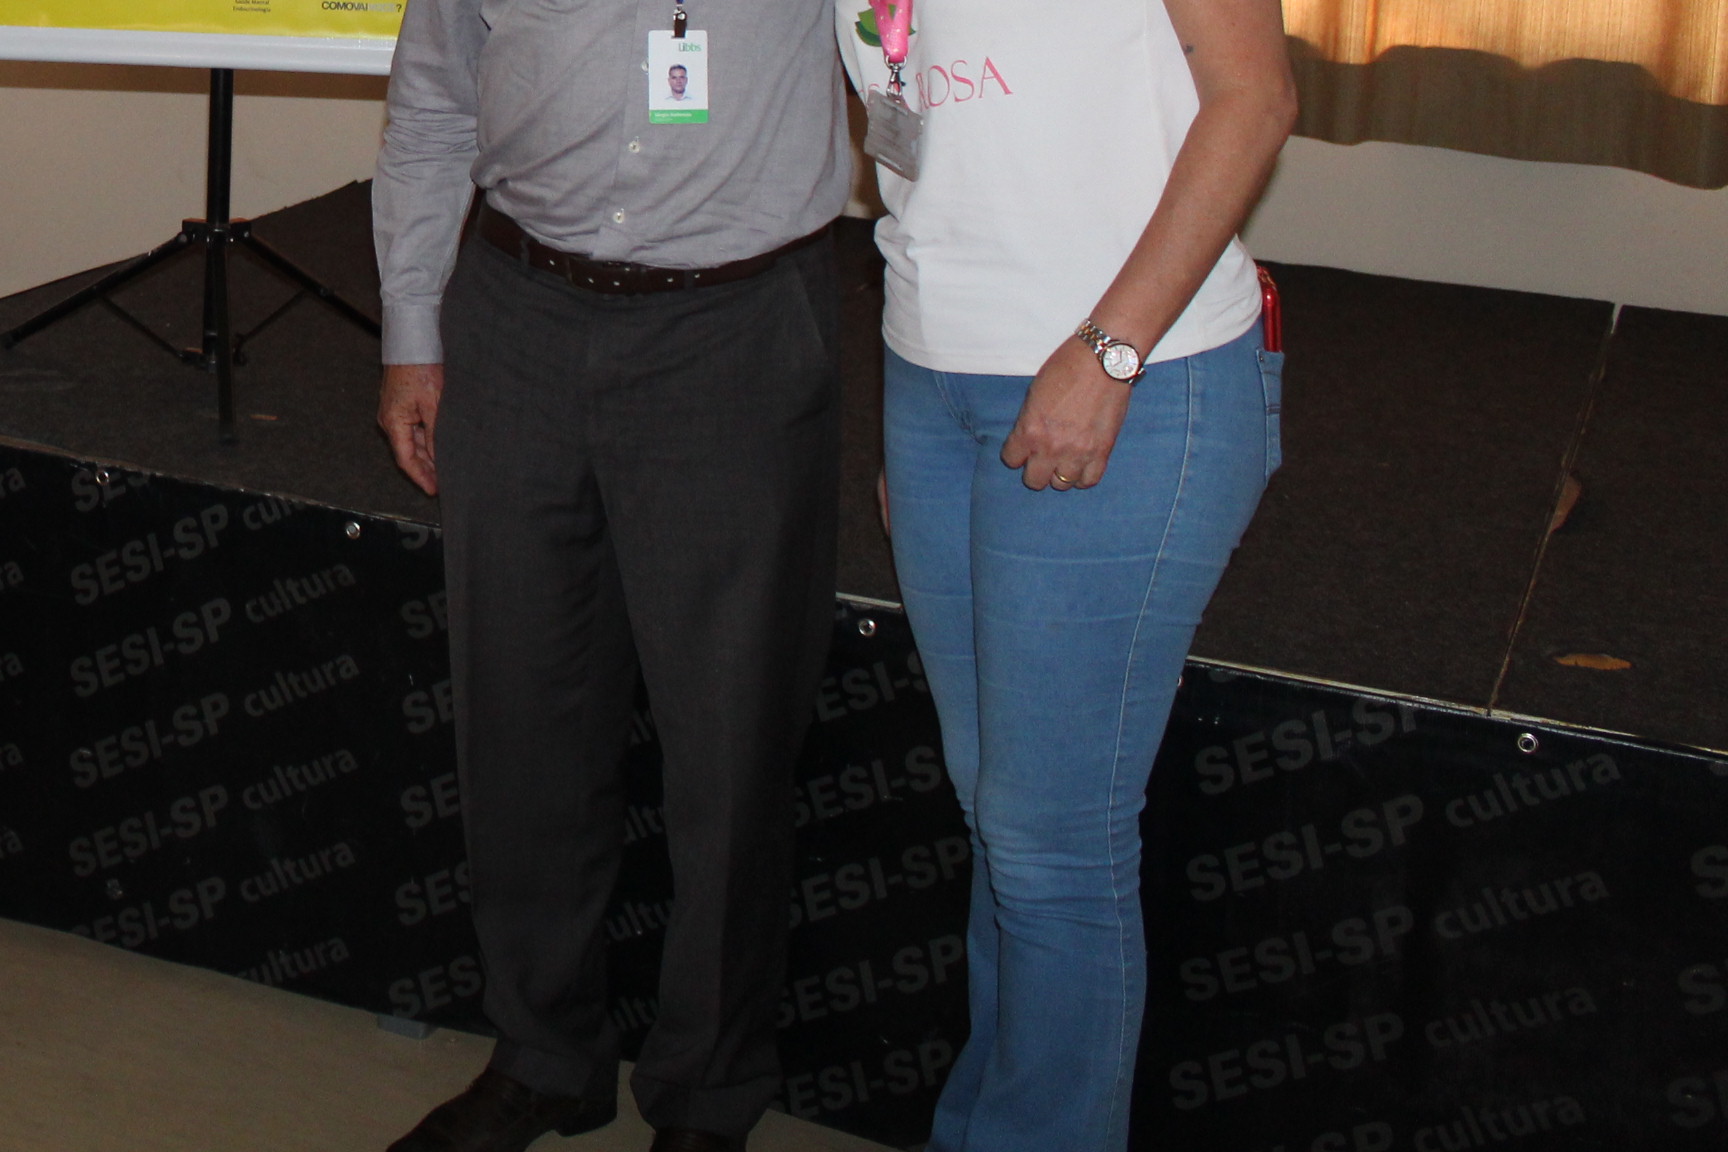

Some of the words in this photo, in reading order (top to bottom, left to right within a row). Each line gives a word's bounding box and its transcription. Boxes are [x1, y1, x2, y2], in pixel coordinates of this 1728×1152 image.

[70, 504, 229, 606] SESI-SP
[70, 597, 232, 697] SESI-SP
[245, 564, 356, 623] cultura
[69, 692, 230, 788] SESI-SP
[244, 654, 360, 717] cultura
[69, 785, 229, 876] SESI-SP
[242, 748, 358, 811] cultura
[240, 842, 355, 903] cultura
[1185, 794, 1425, 902] SESI-SP
[1445, 752, 1621, 828] cultura
[1179, 904, 1415, 1002] SESI-SP
[1434, 869, 1610, 940] cultura
[1169, 1012, 1405, 1112] SESI-SP
[1424, 986, 1598, 1051] cultura
